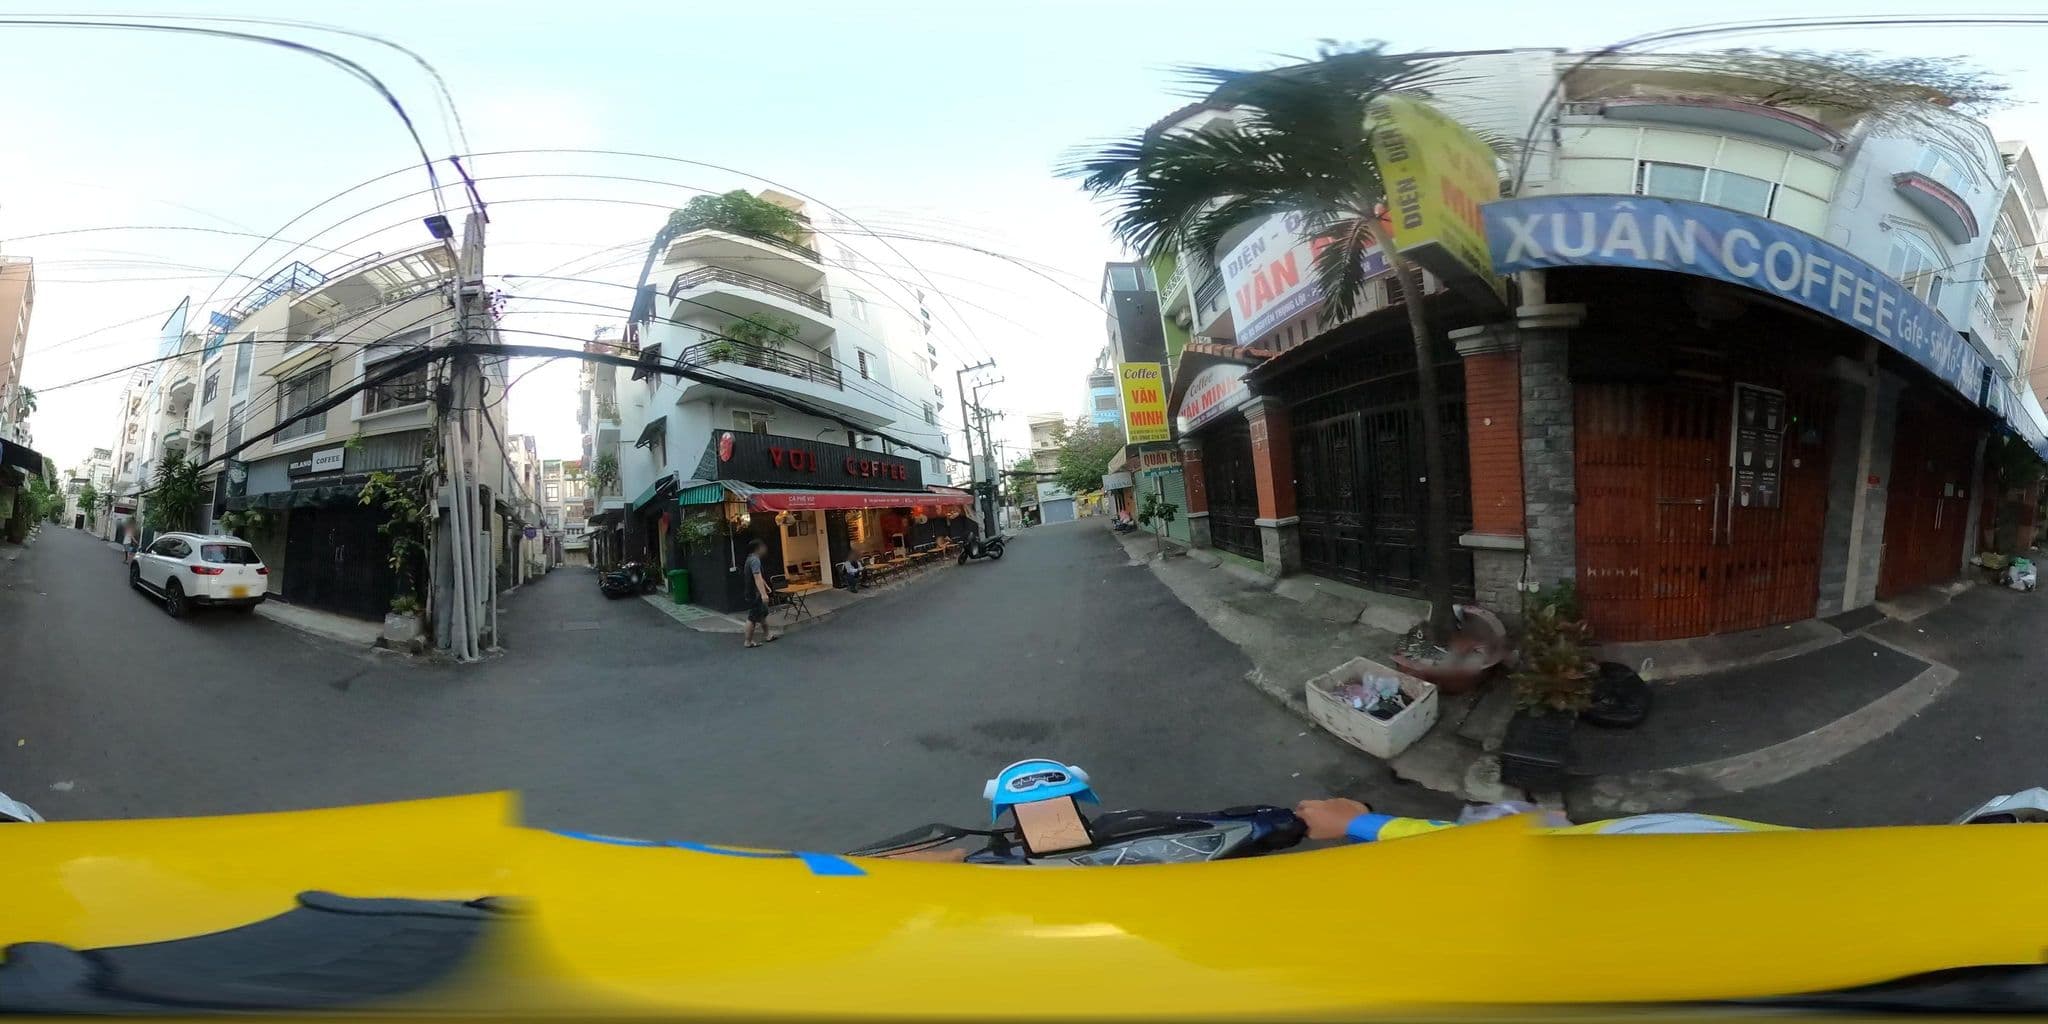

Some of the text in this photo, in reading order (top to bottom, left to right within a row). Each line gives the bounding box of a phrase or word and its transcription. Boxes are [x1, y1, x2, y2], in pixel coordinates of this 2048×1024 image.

[1503, 201, 1697, 265] XUÂN
[1722, 228, 1896, 338] COFFEE
[1235, 249, 1300, 320] VĂN
[1897, 308, 1923, 350] Cafe
[1124, 368, 1158, 380] Coffee
[1131, 386, 1158, 404] VĂN
[1130, 410, 1165, 427] MINH
[316, 455, 341, 465] COFFEE
[846, 455, 907, 481] COFFEE
